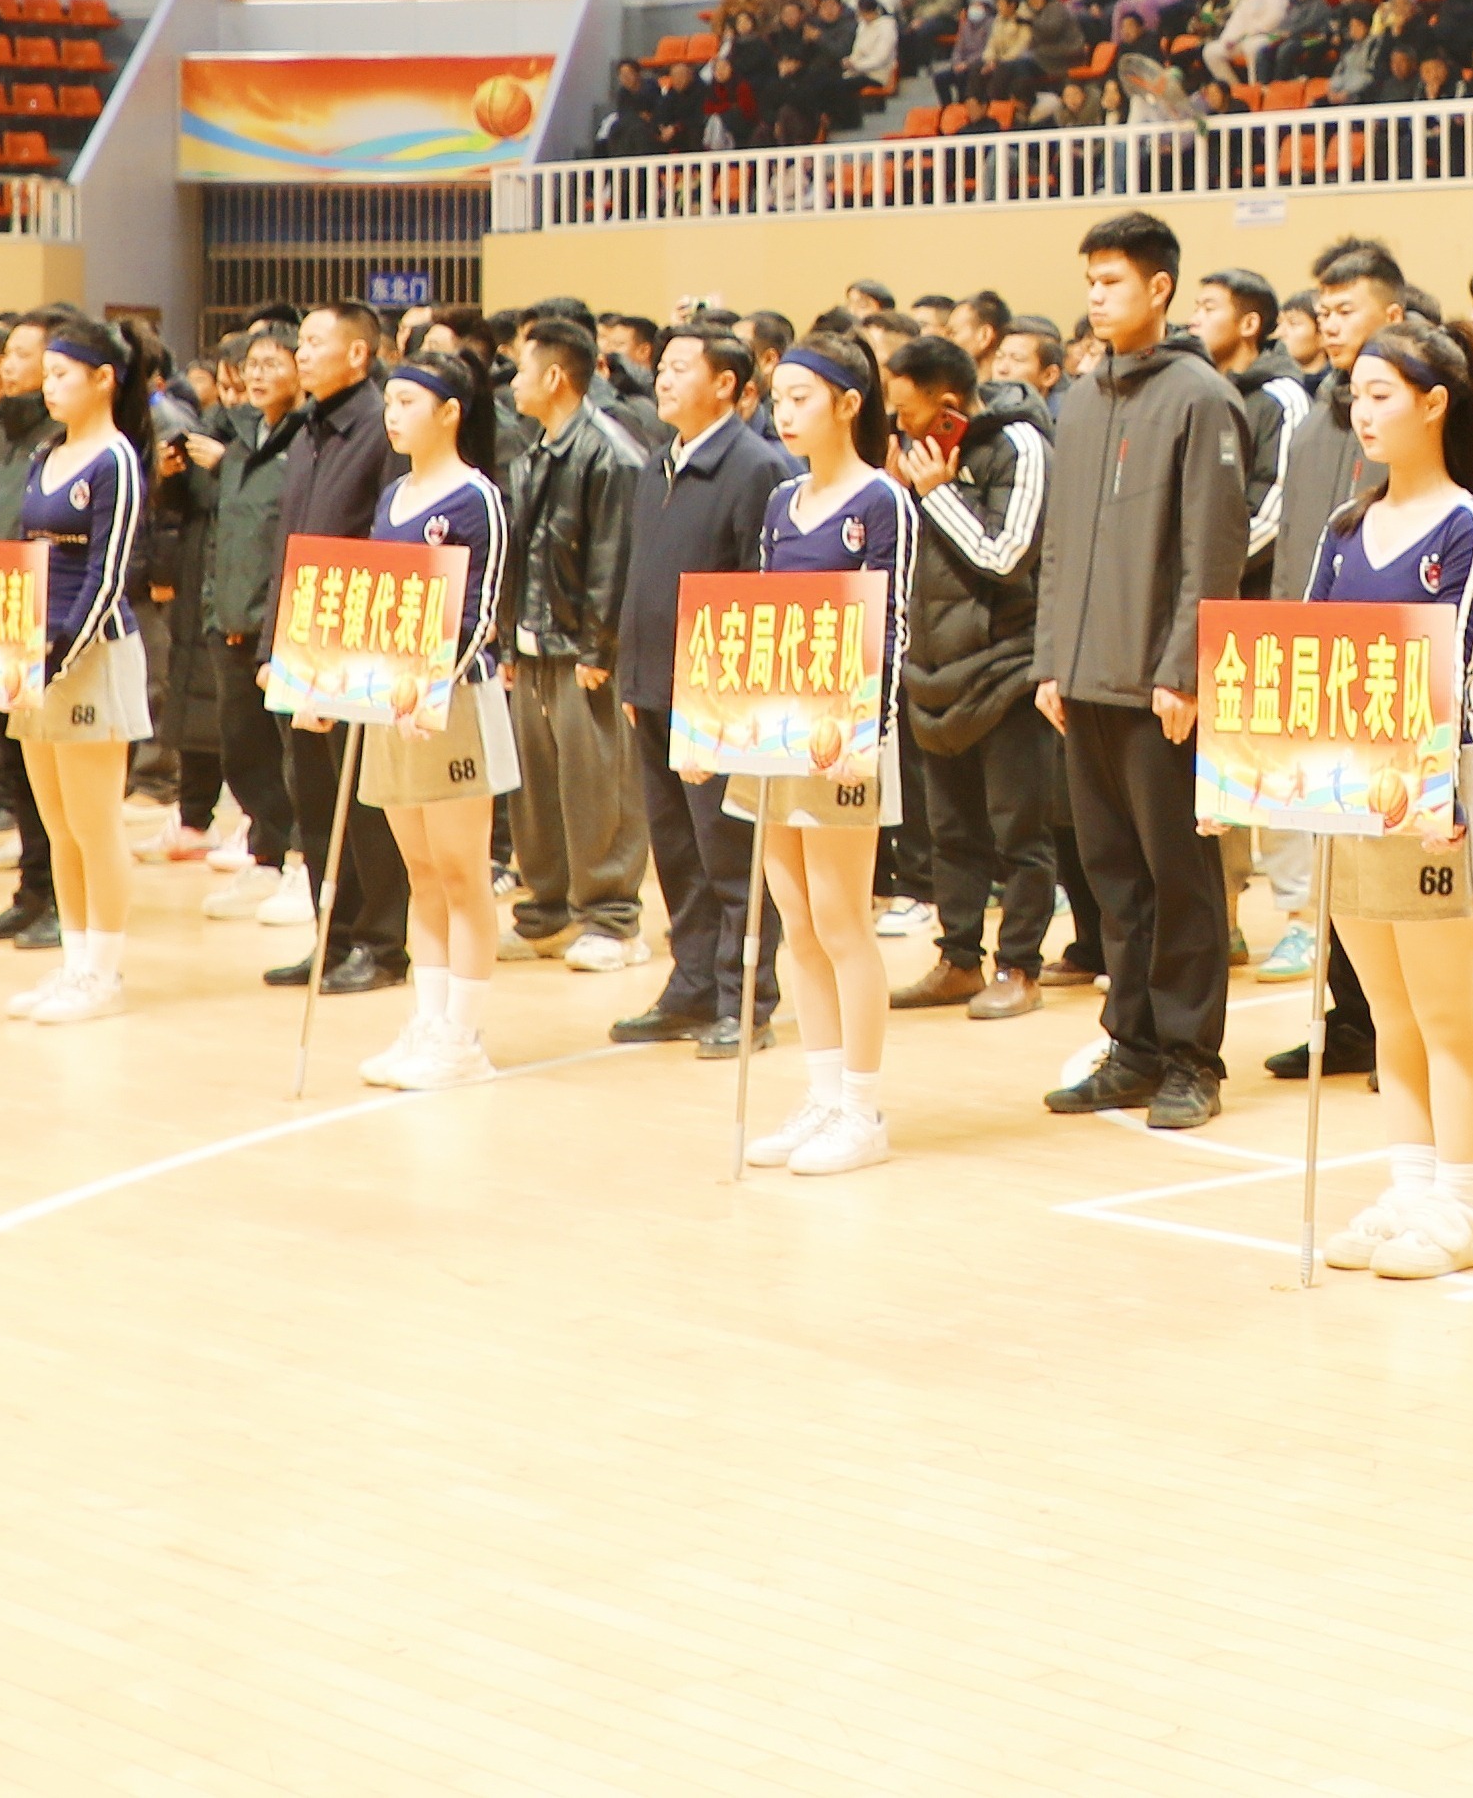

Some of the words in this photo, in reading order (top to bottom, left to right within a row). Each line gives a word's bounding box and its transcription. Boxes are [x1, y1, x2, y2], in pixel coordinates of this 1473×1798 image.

[369, 272, 429, 303] 东北门
[286, 565, 450, 657] 通羊镇代表队
[688, 599, 867, 695] 公安局代表队
[1214, 631, 1436, 744] 金监局代表队
[448, 758, 477, 783] 68
[835, 783, 866, 808] 68
[1419, 865, 1454, 897] 68
